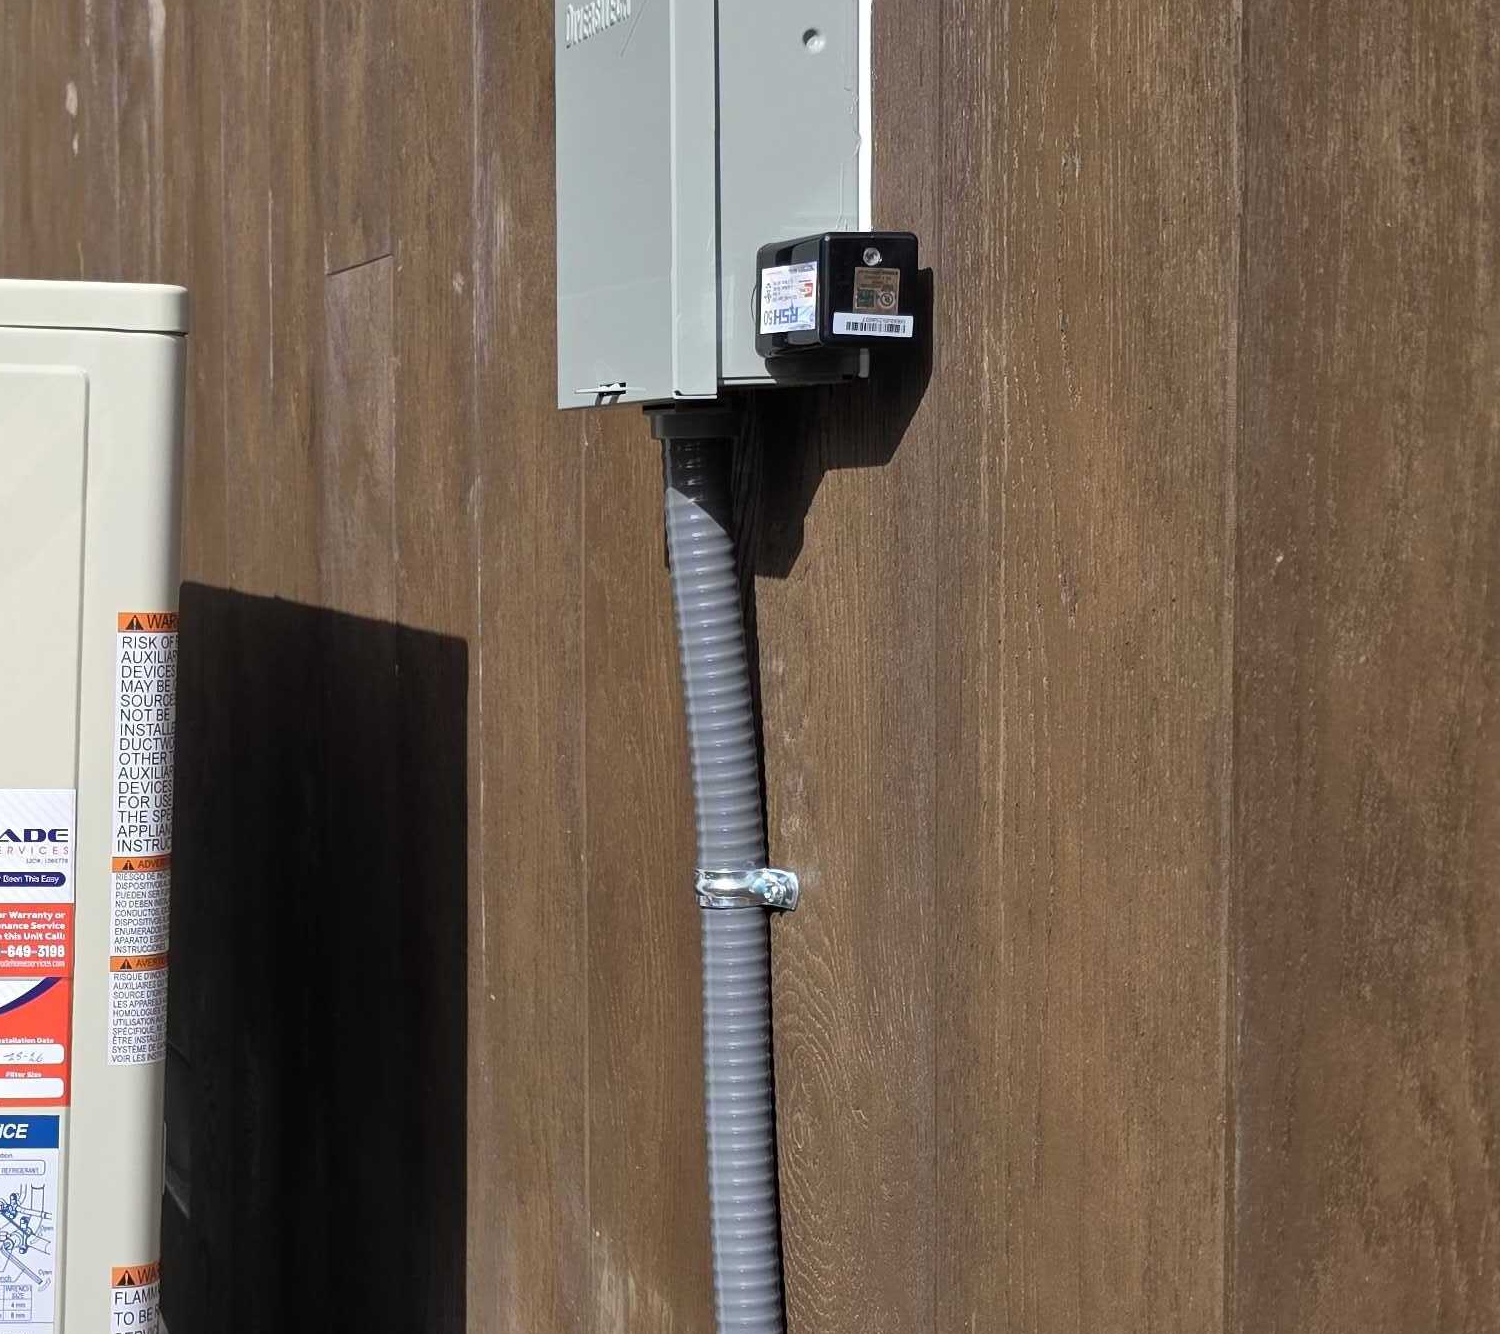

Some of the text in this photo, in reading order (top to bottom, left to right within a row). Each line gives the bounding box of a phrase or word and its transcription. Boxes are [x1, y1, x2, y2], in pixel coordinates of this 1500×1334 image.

[122, 636, 157, 649] RISK
[161, 636, 173, 649] OF
[121, 680, 170, 692] MAY BE
[121, 709, 170, 721] NOT BE
[119, 753, 166, 765] OTHER
[119, 796, 150, 808] FOR
[118, 811, 148, 823] THE
[3, 875, 22, 884] Been
[25, 875, 39, 884] This
[41, 875, 59, 884] Easy
[116, 891, 146, 899] PUEDEN
[9, 911, 53, 921] Warranty
[31, 922, 65, 930] Service
[114, 1308, 152, 1326] TO BE
